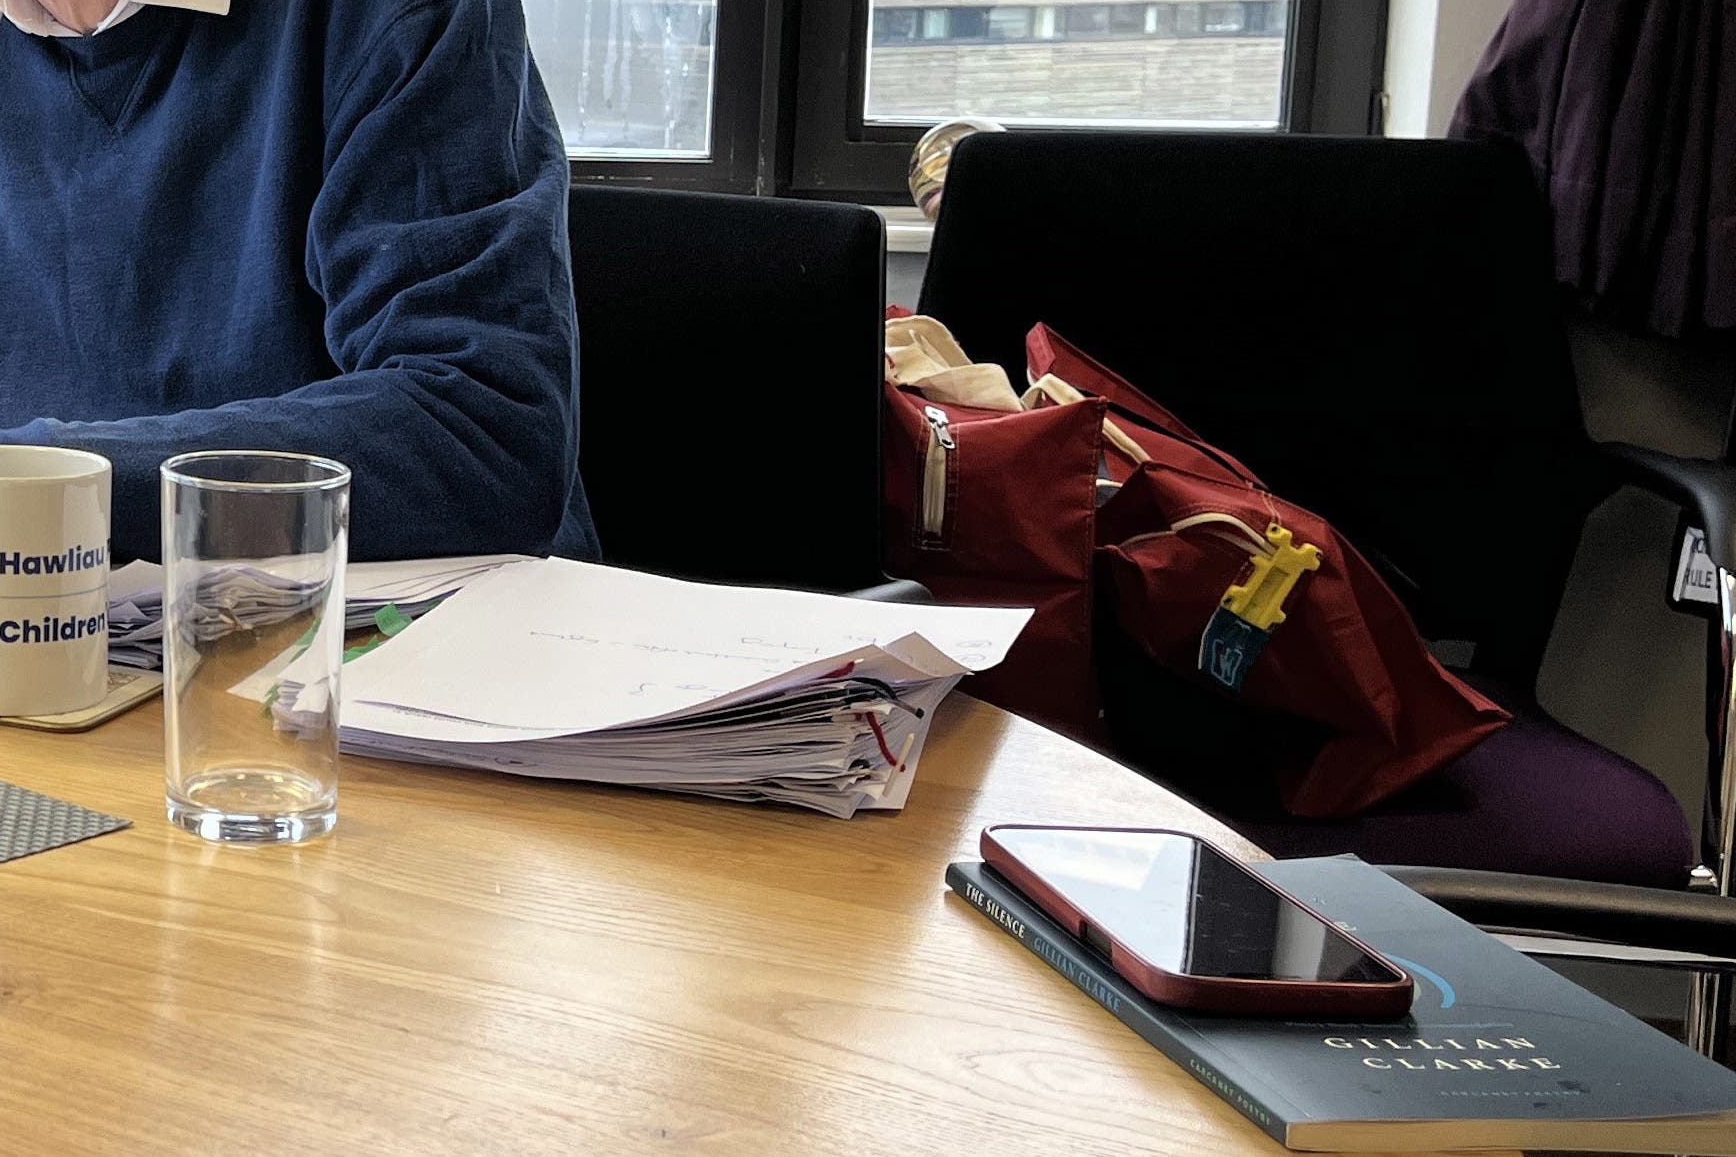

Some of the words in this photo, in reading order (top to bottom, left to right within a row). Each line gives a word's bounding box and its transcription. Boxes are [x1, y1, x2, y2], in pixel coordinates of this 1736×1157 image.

[0, 544, 105, 575] Hawliau
[965, 883, 984, 907] THE
[986, 900, 1026, 939] SILENCE
[1033, 936, 1075, 978] GILLIAN
[1078, 971, 1122, 1013] CLARKE
[1323, 1037, 1536, 1050] GILLIAN
[1362, 1057, 1561, 1070] CLARKE
